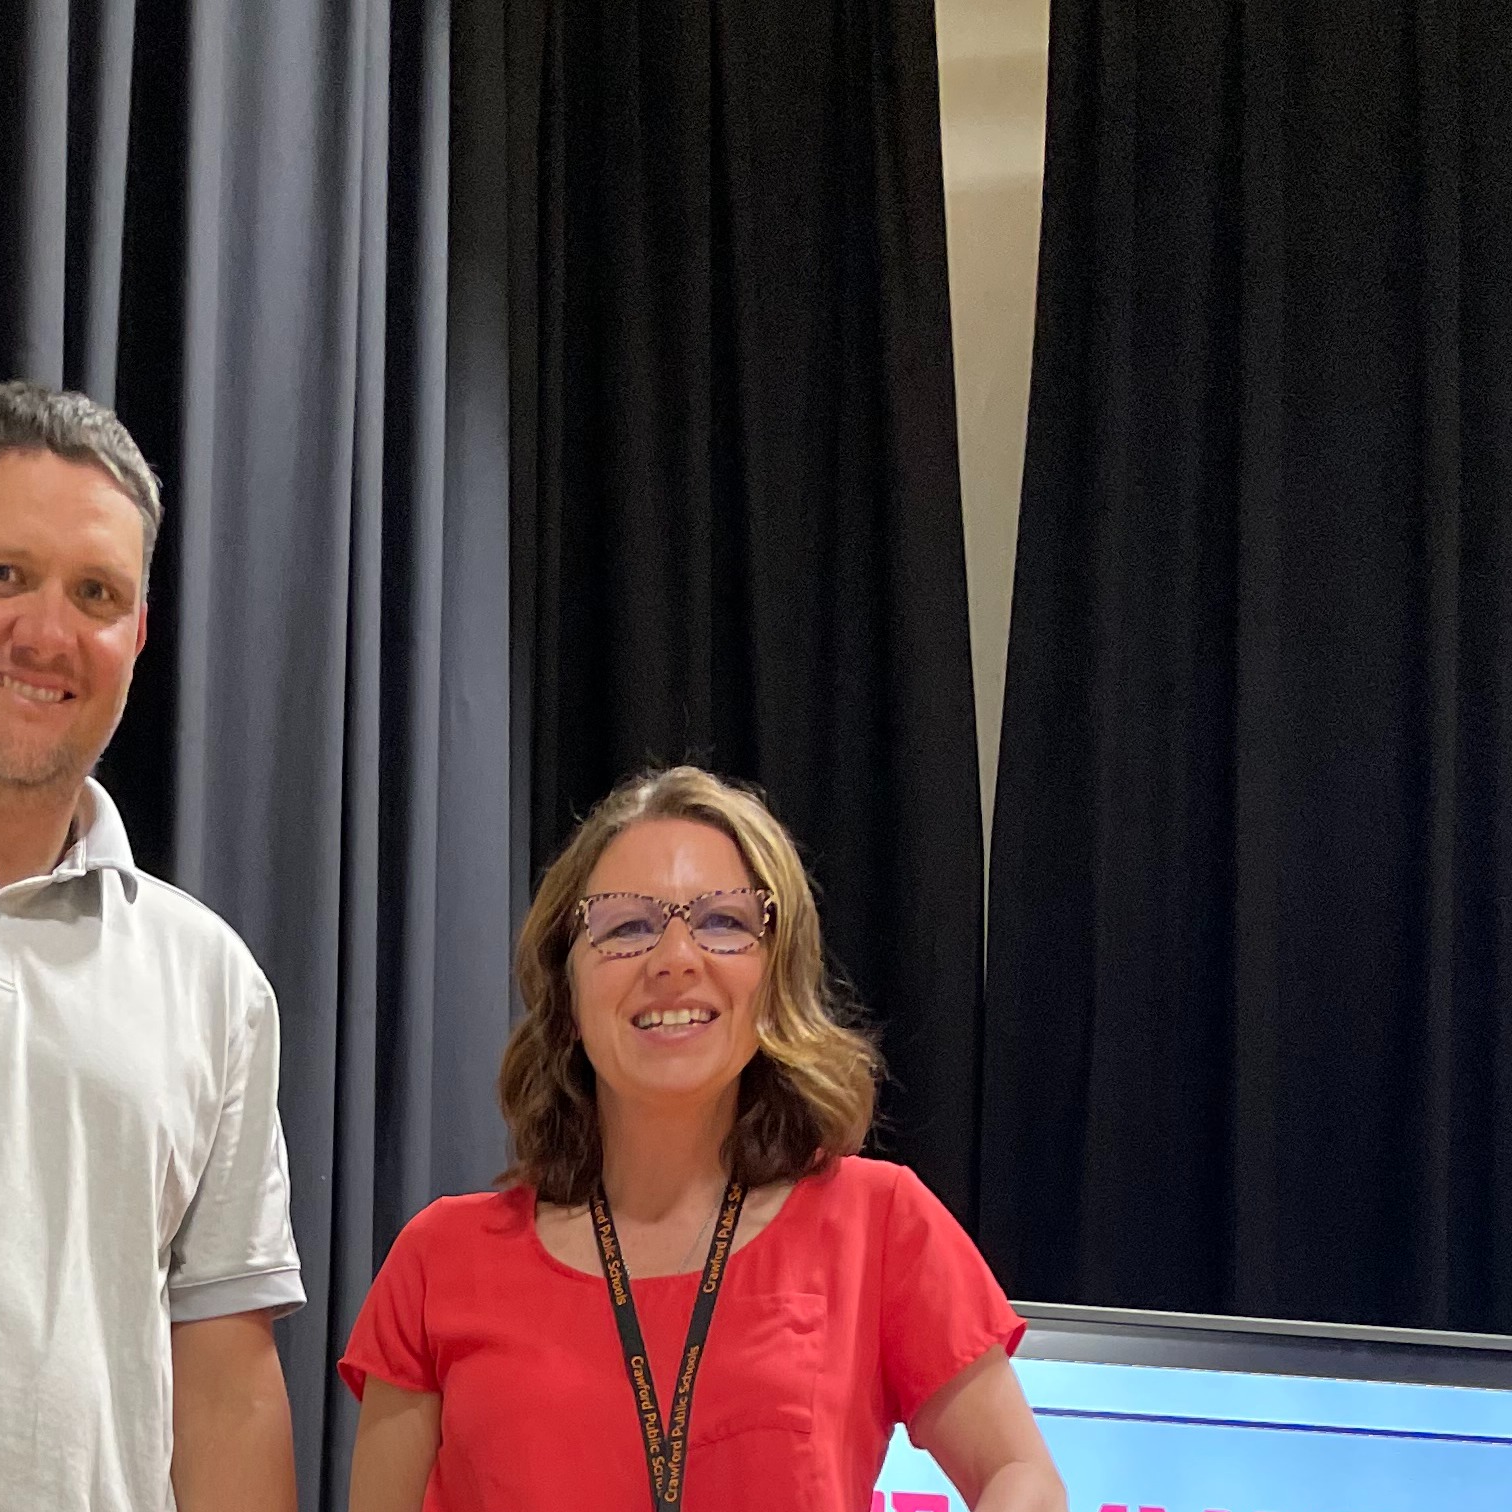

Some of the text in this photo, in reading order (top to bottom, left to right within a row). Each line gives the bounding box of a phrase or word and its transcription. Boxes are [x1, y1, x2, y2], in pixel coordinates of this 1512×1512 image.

[598, 1225, 616, 1259] Public
[607, 1260, 628, 1306] Schools
[703, 1241, 728, 1294] Crawford
[631, 1355, 654, 1411] Crawford
[644, 1413, 662, 1454] Public
[664, 1345, 700, 1503] Crawford Public Schools
